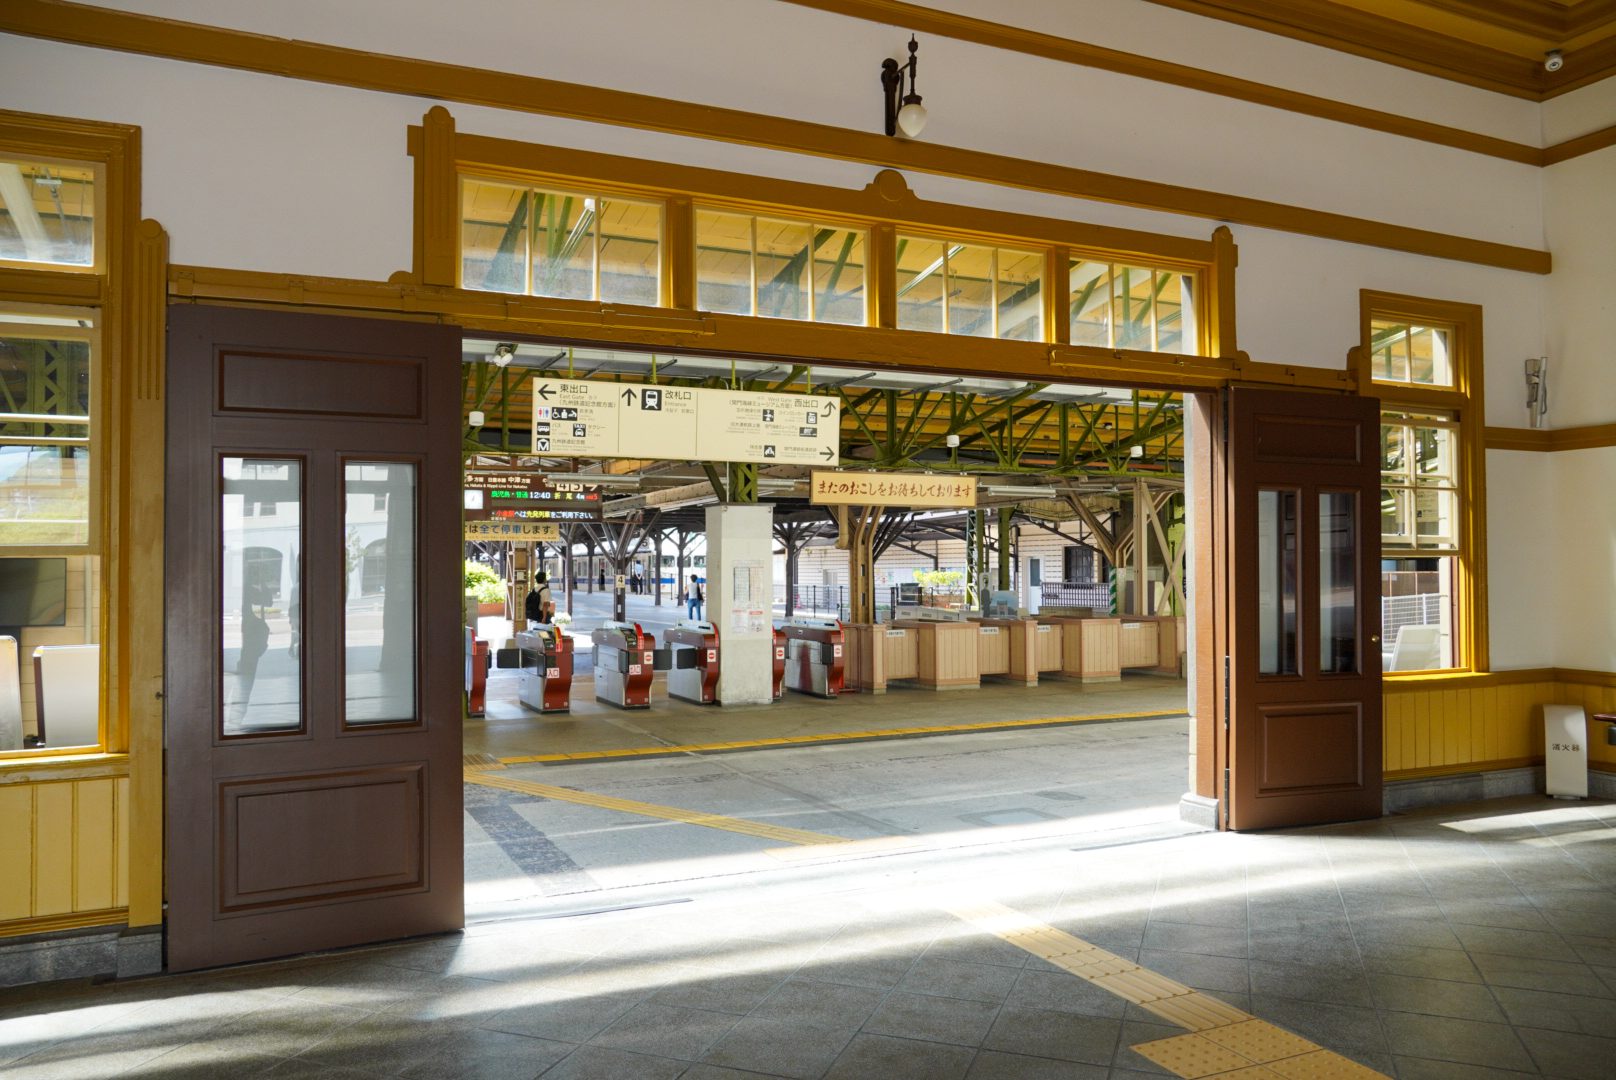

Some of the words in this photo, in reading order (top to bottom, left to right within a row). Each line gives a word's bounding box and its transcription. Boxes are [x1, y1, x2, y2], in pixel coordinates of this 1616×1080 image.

[559, 384, 588, 394] 東出口
[664, 390, 692, 400] 改札口
[794, 398, 819, 408] 西出口
[816, 480, 972, 499] またのおこしをお待ちしております
[529, 491, 551, 499] 12:40
[618, 576, 623, 584] 4
[548, 669, 559, 677] 入口
[1551, 743, 1580, 752] 消火器
